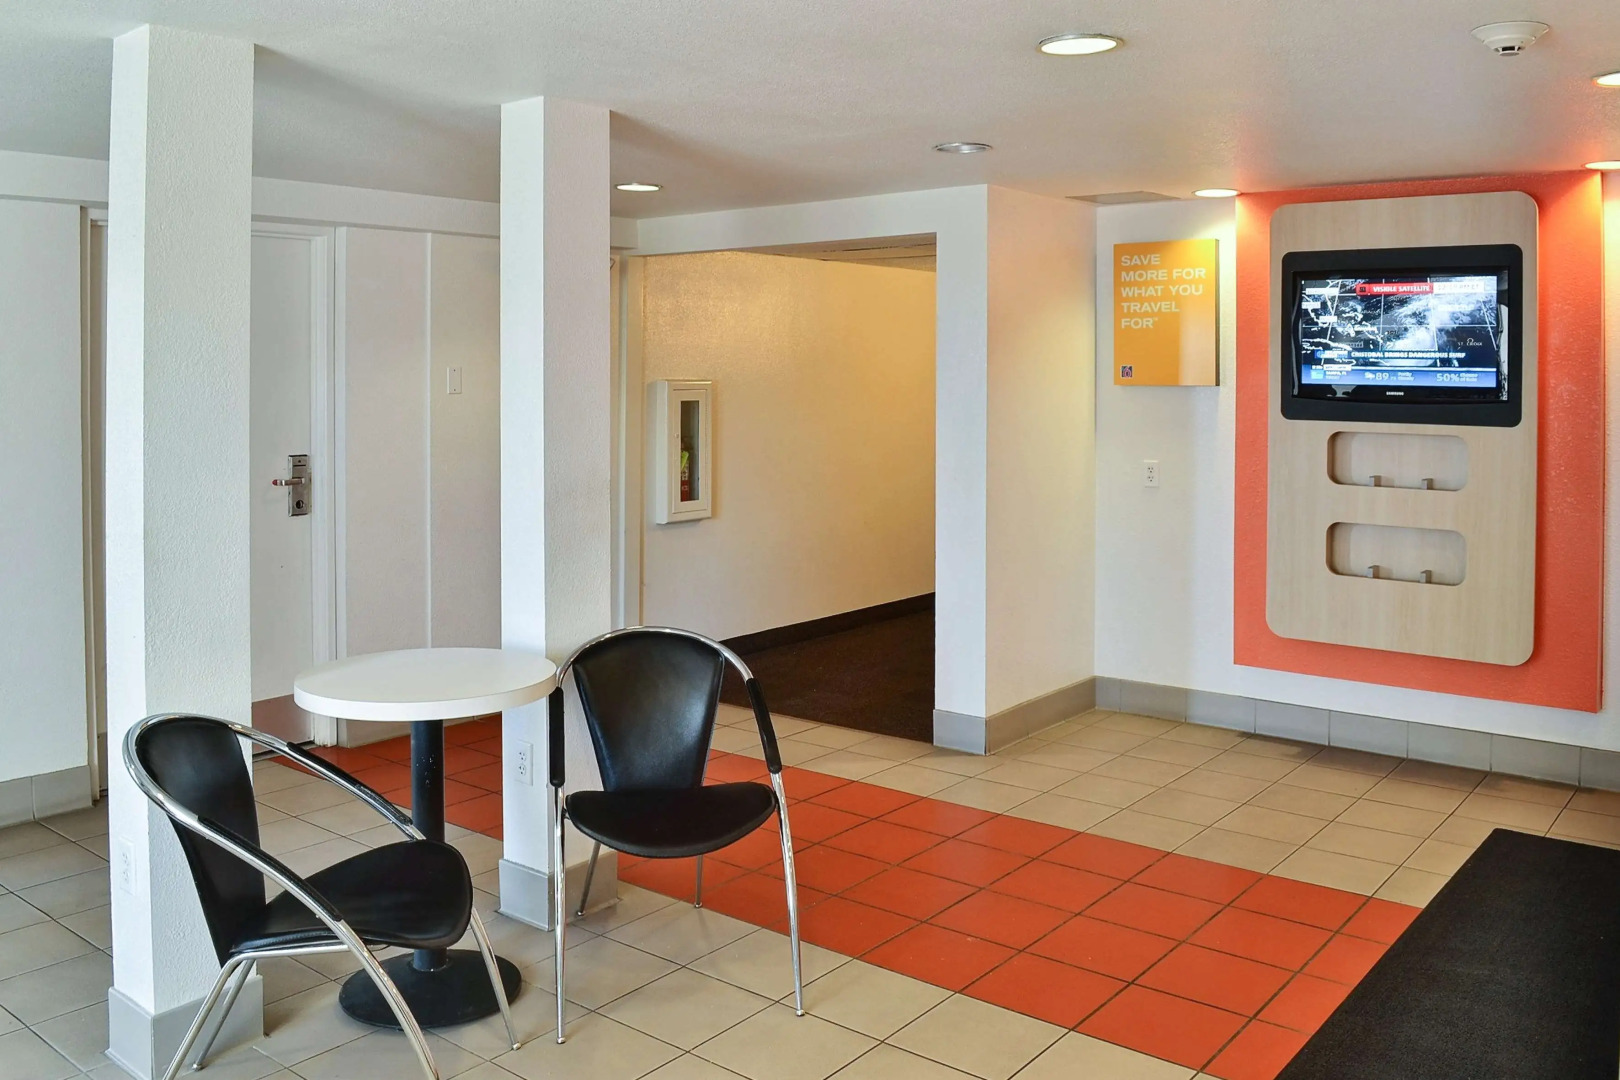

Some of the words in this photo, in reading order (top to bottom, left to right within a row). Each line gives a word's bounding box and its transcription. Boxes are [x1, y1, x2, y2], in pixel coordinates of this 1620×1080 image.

[1121, 254, 1160, 266] SAVE
[1121, 269, 1168, 282] MORE
[1172, 267, 1206, 280] FOR
[1121, 285, 1164, 297] WHAT
[1169, 284, 1203, 296] YOU
[1121, 301, 1180, 312] TRAVEL
[1376, 372, 1389, 381] 89
[1436, 373, 1459, 382] 50%
